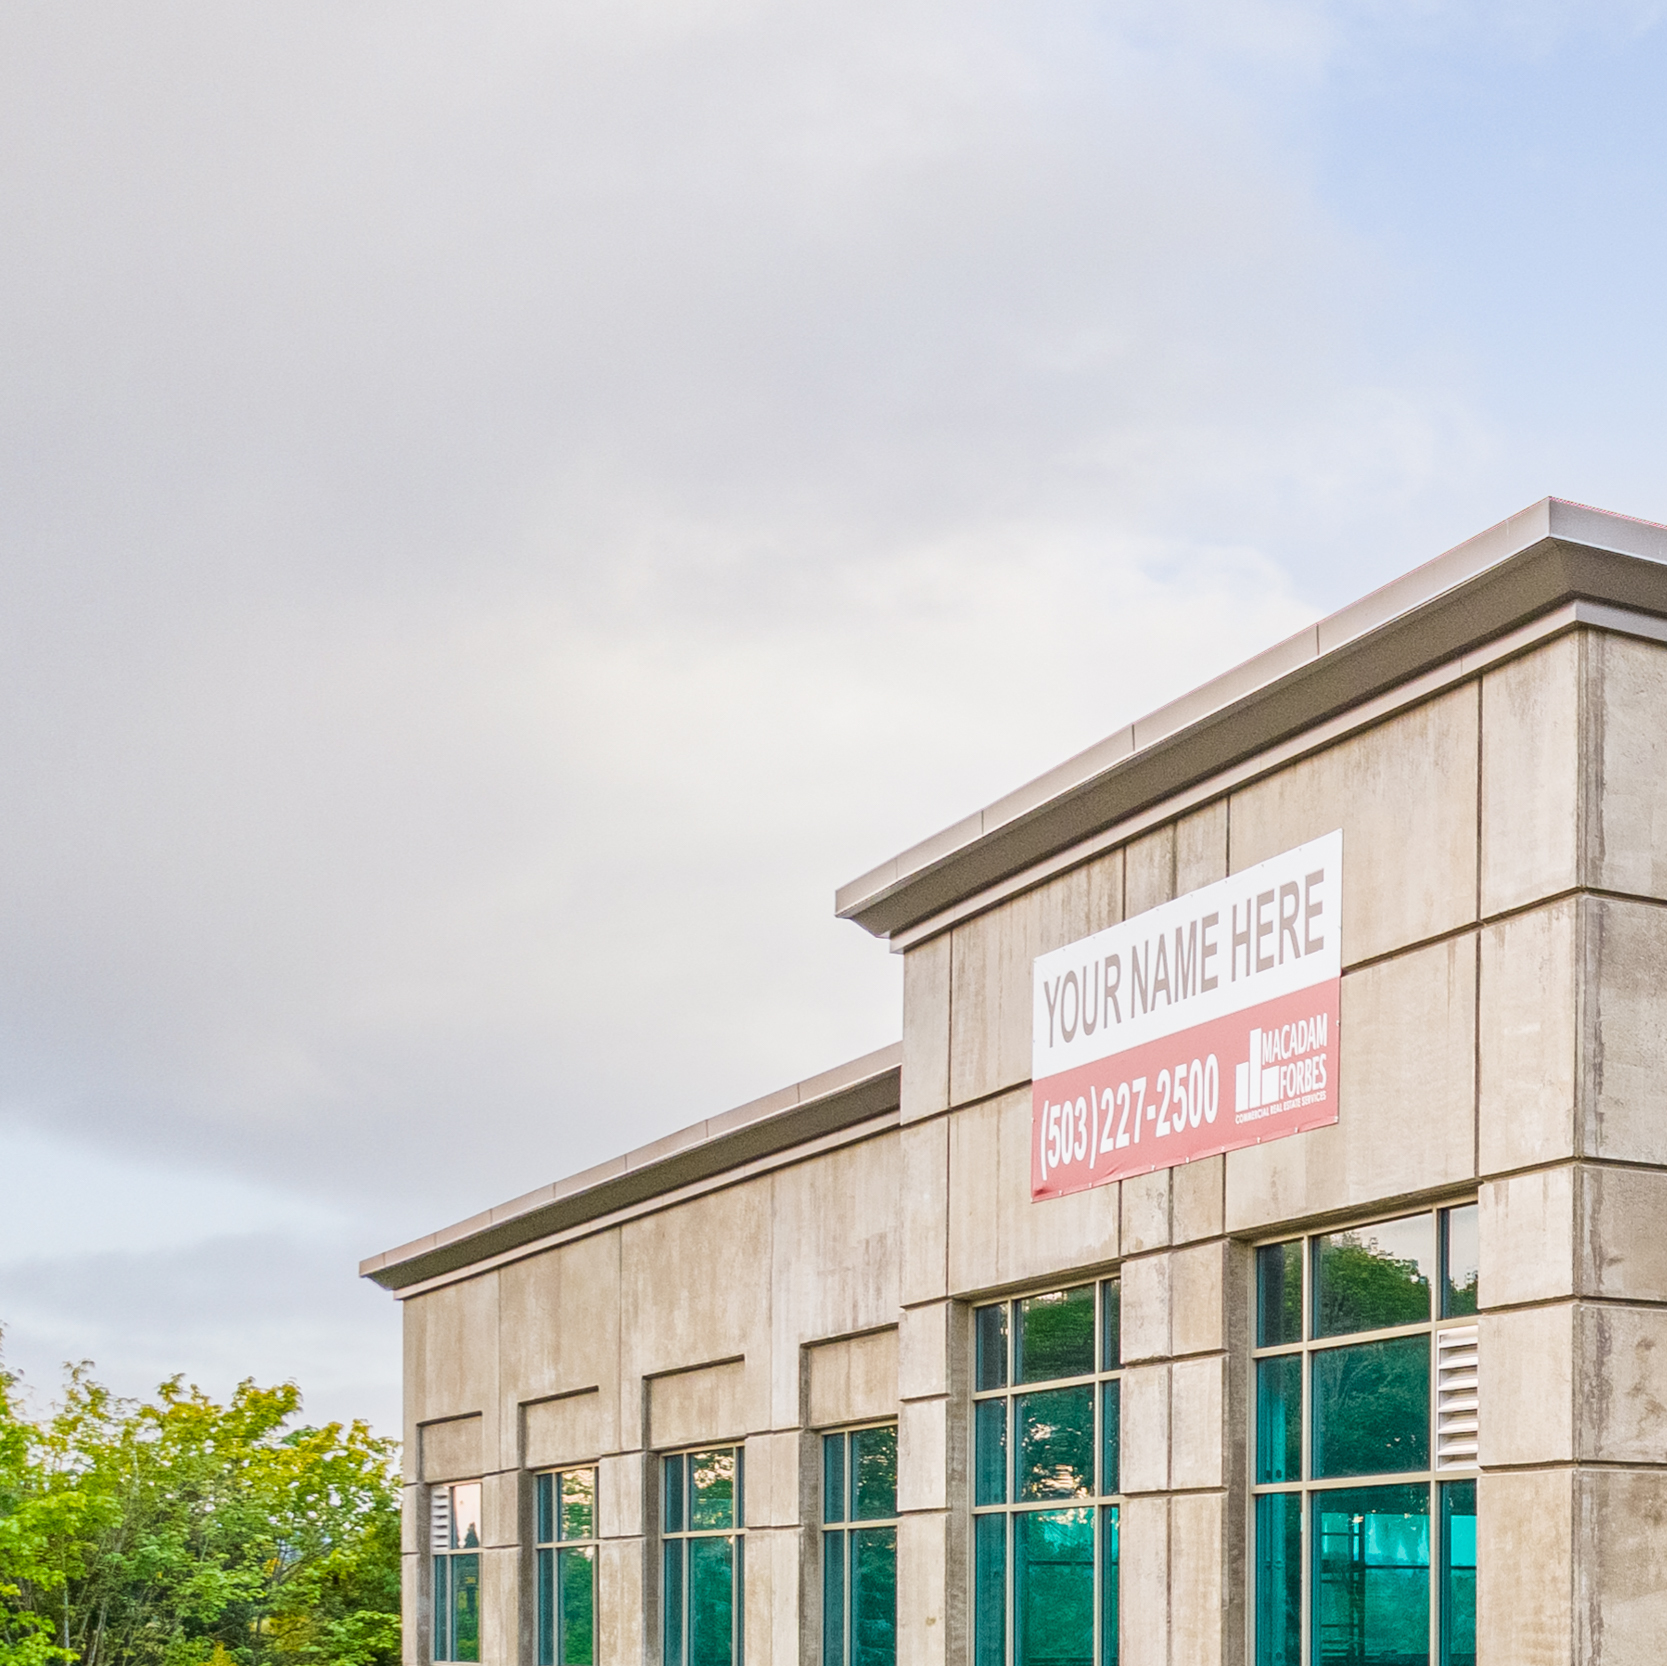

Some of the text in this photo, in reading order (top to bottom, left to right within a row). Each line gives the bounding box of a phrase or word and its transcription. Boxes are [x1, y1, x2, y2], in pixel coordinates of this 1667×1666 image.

[1043, 867, 1325, 1049] YOUR NAME HERE
[1262, 1012, 1328, 1066] MACADAM
[1280, 1053, 1327, 1100] FORBES
[1040, 1053, 1219, 1181] (503)227-2500
[1235, 1106, 1270, 1125] COMMERCIAL
